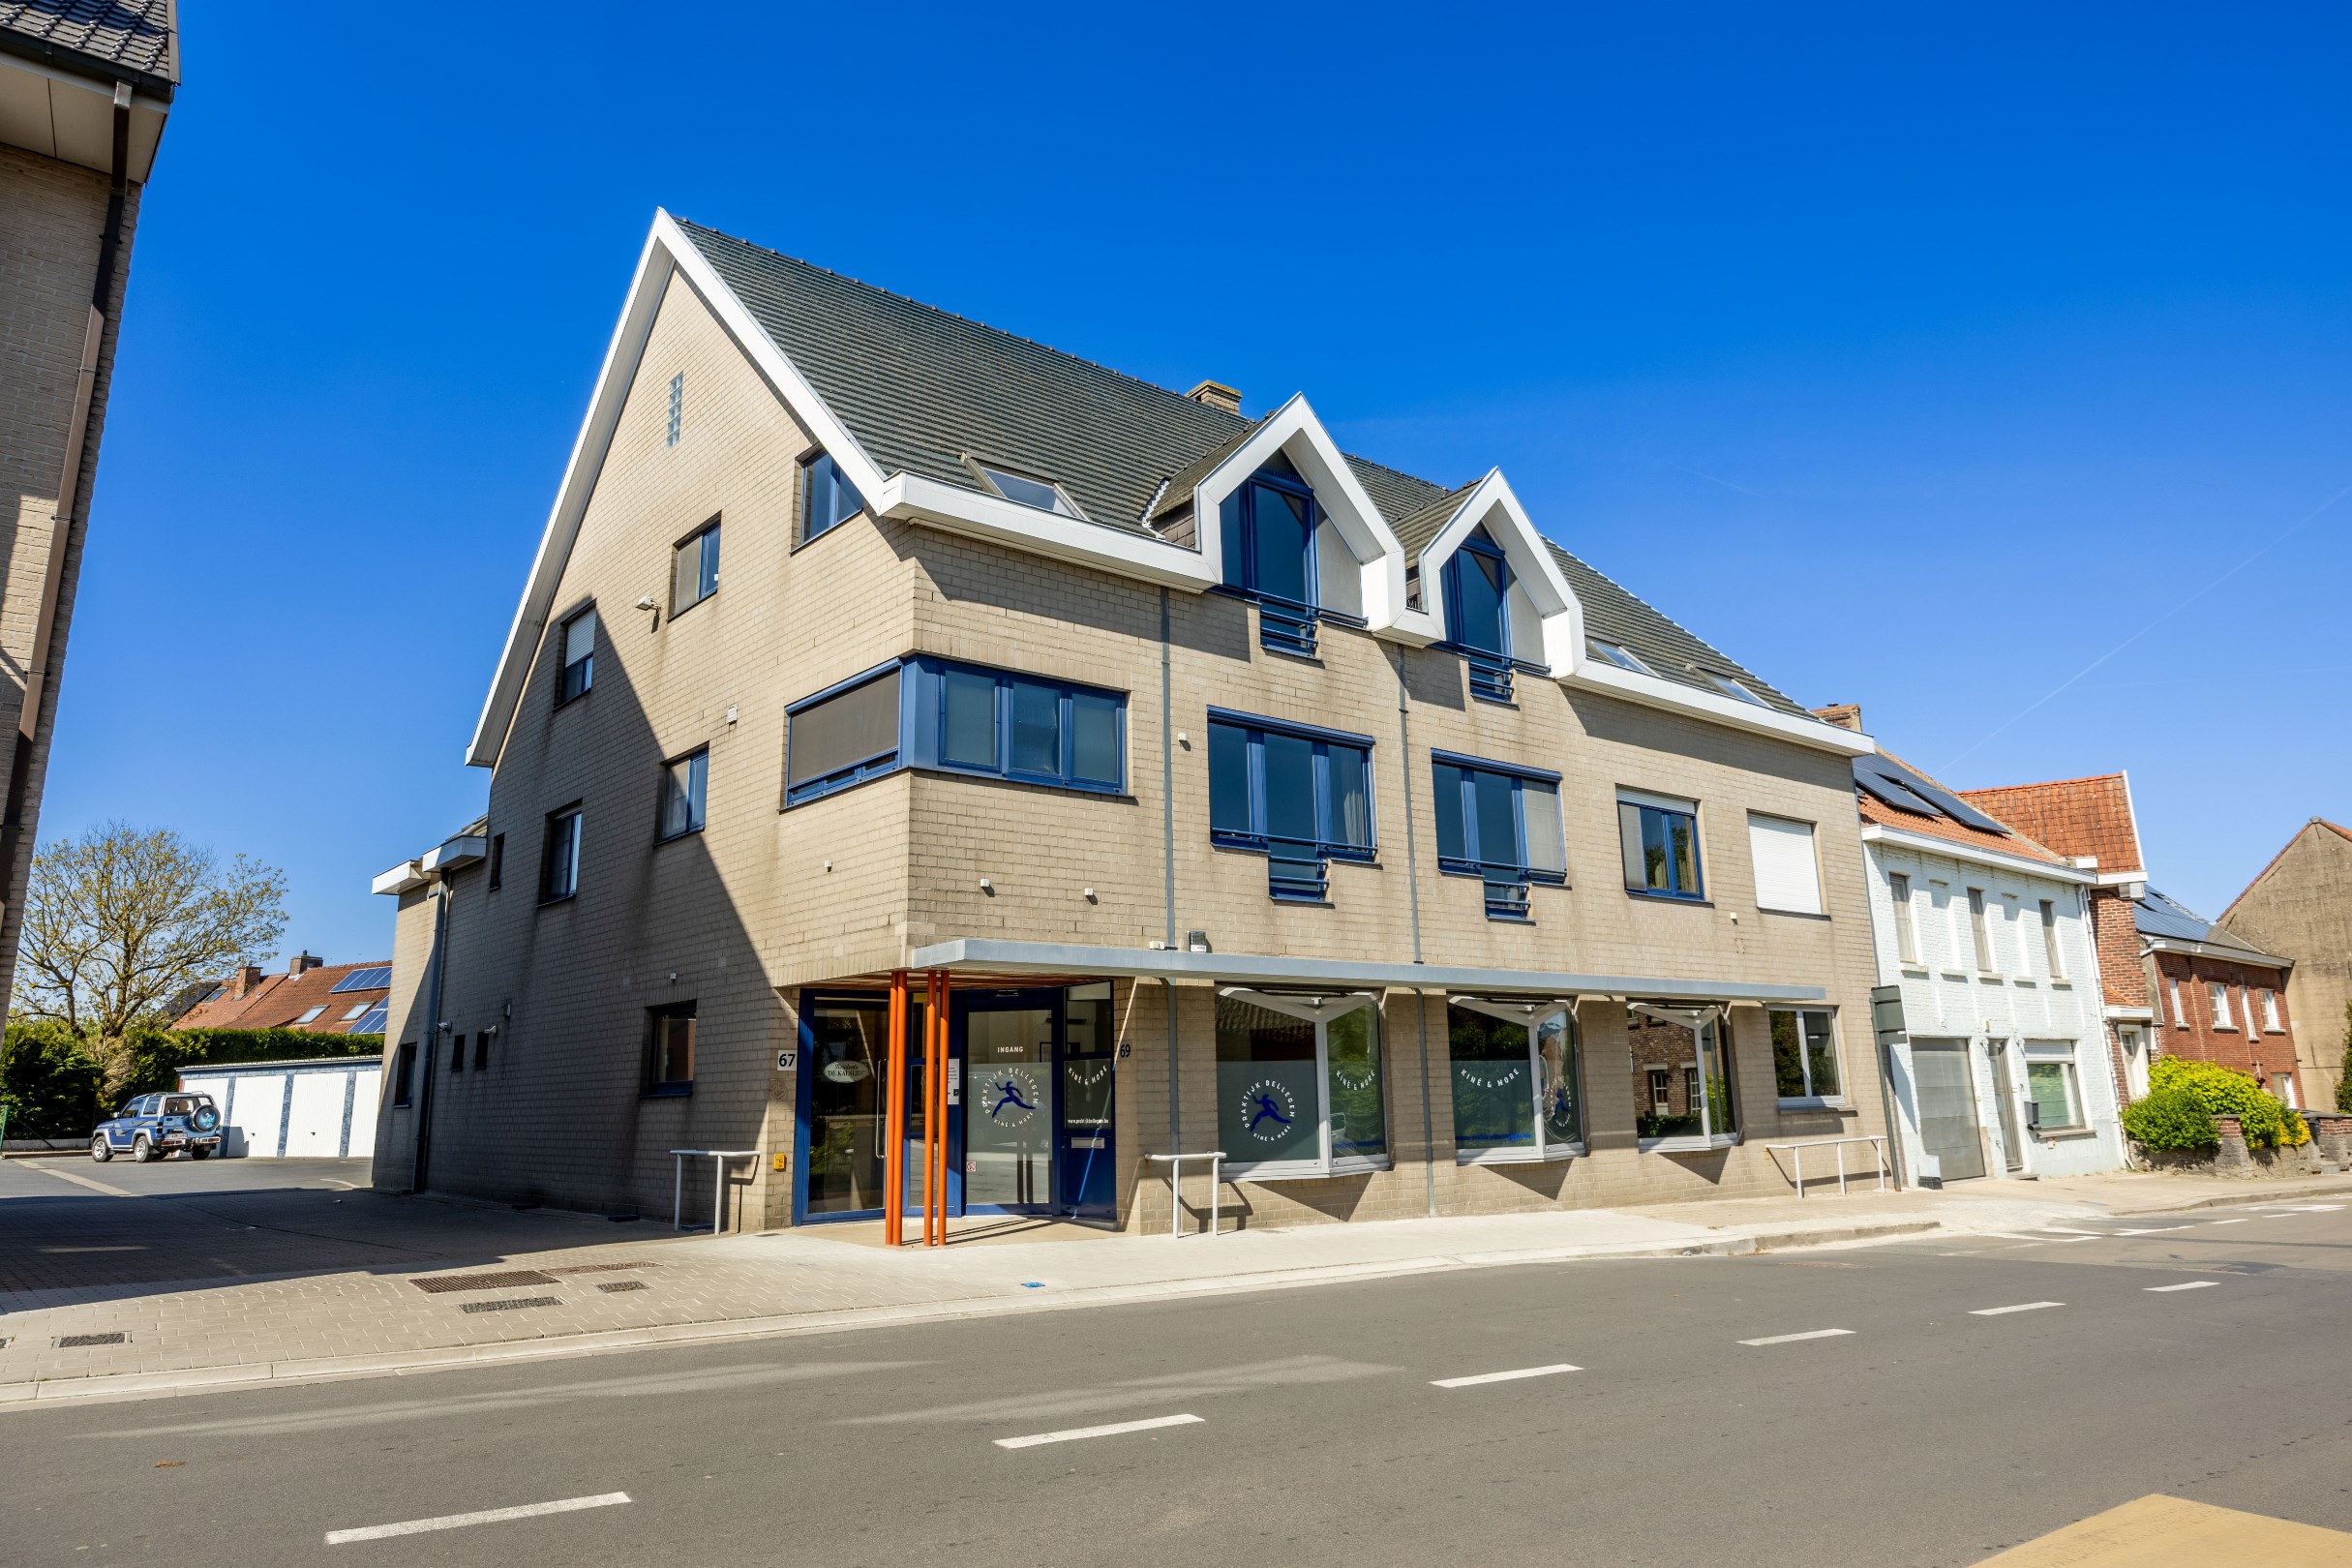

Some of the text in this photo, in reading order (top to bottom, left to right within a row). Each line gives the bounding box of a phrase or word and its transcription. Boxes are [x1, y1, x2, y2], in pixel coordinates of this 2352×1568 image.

[1120, 1043, 1131, 1058] 69
[778, 1053, 796, 1067] 67
[1091, 1065, 1107, 1084] MORE
[1360, 1070, 1374, 1089] MORE
[1496, 1068, 1520, 1086] MORE
[981, 1070, 1004, 1115] PRAKTIJK
[1241, 1081, 1261, 1129] PRAKTIJK
[1277, 1125, 1291, 1138] MORE
